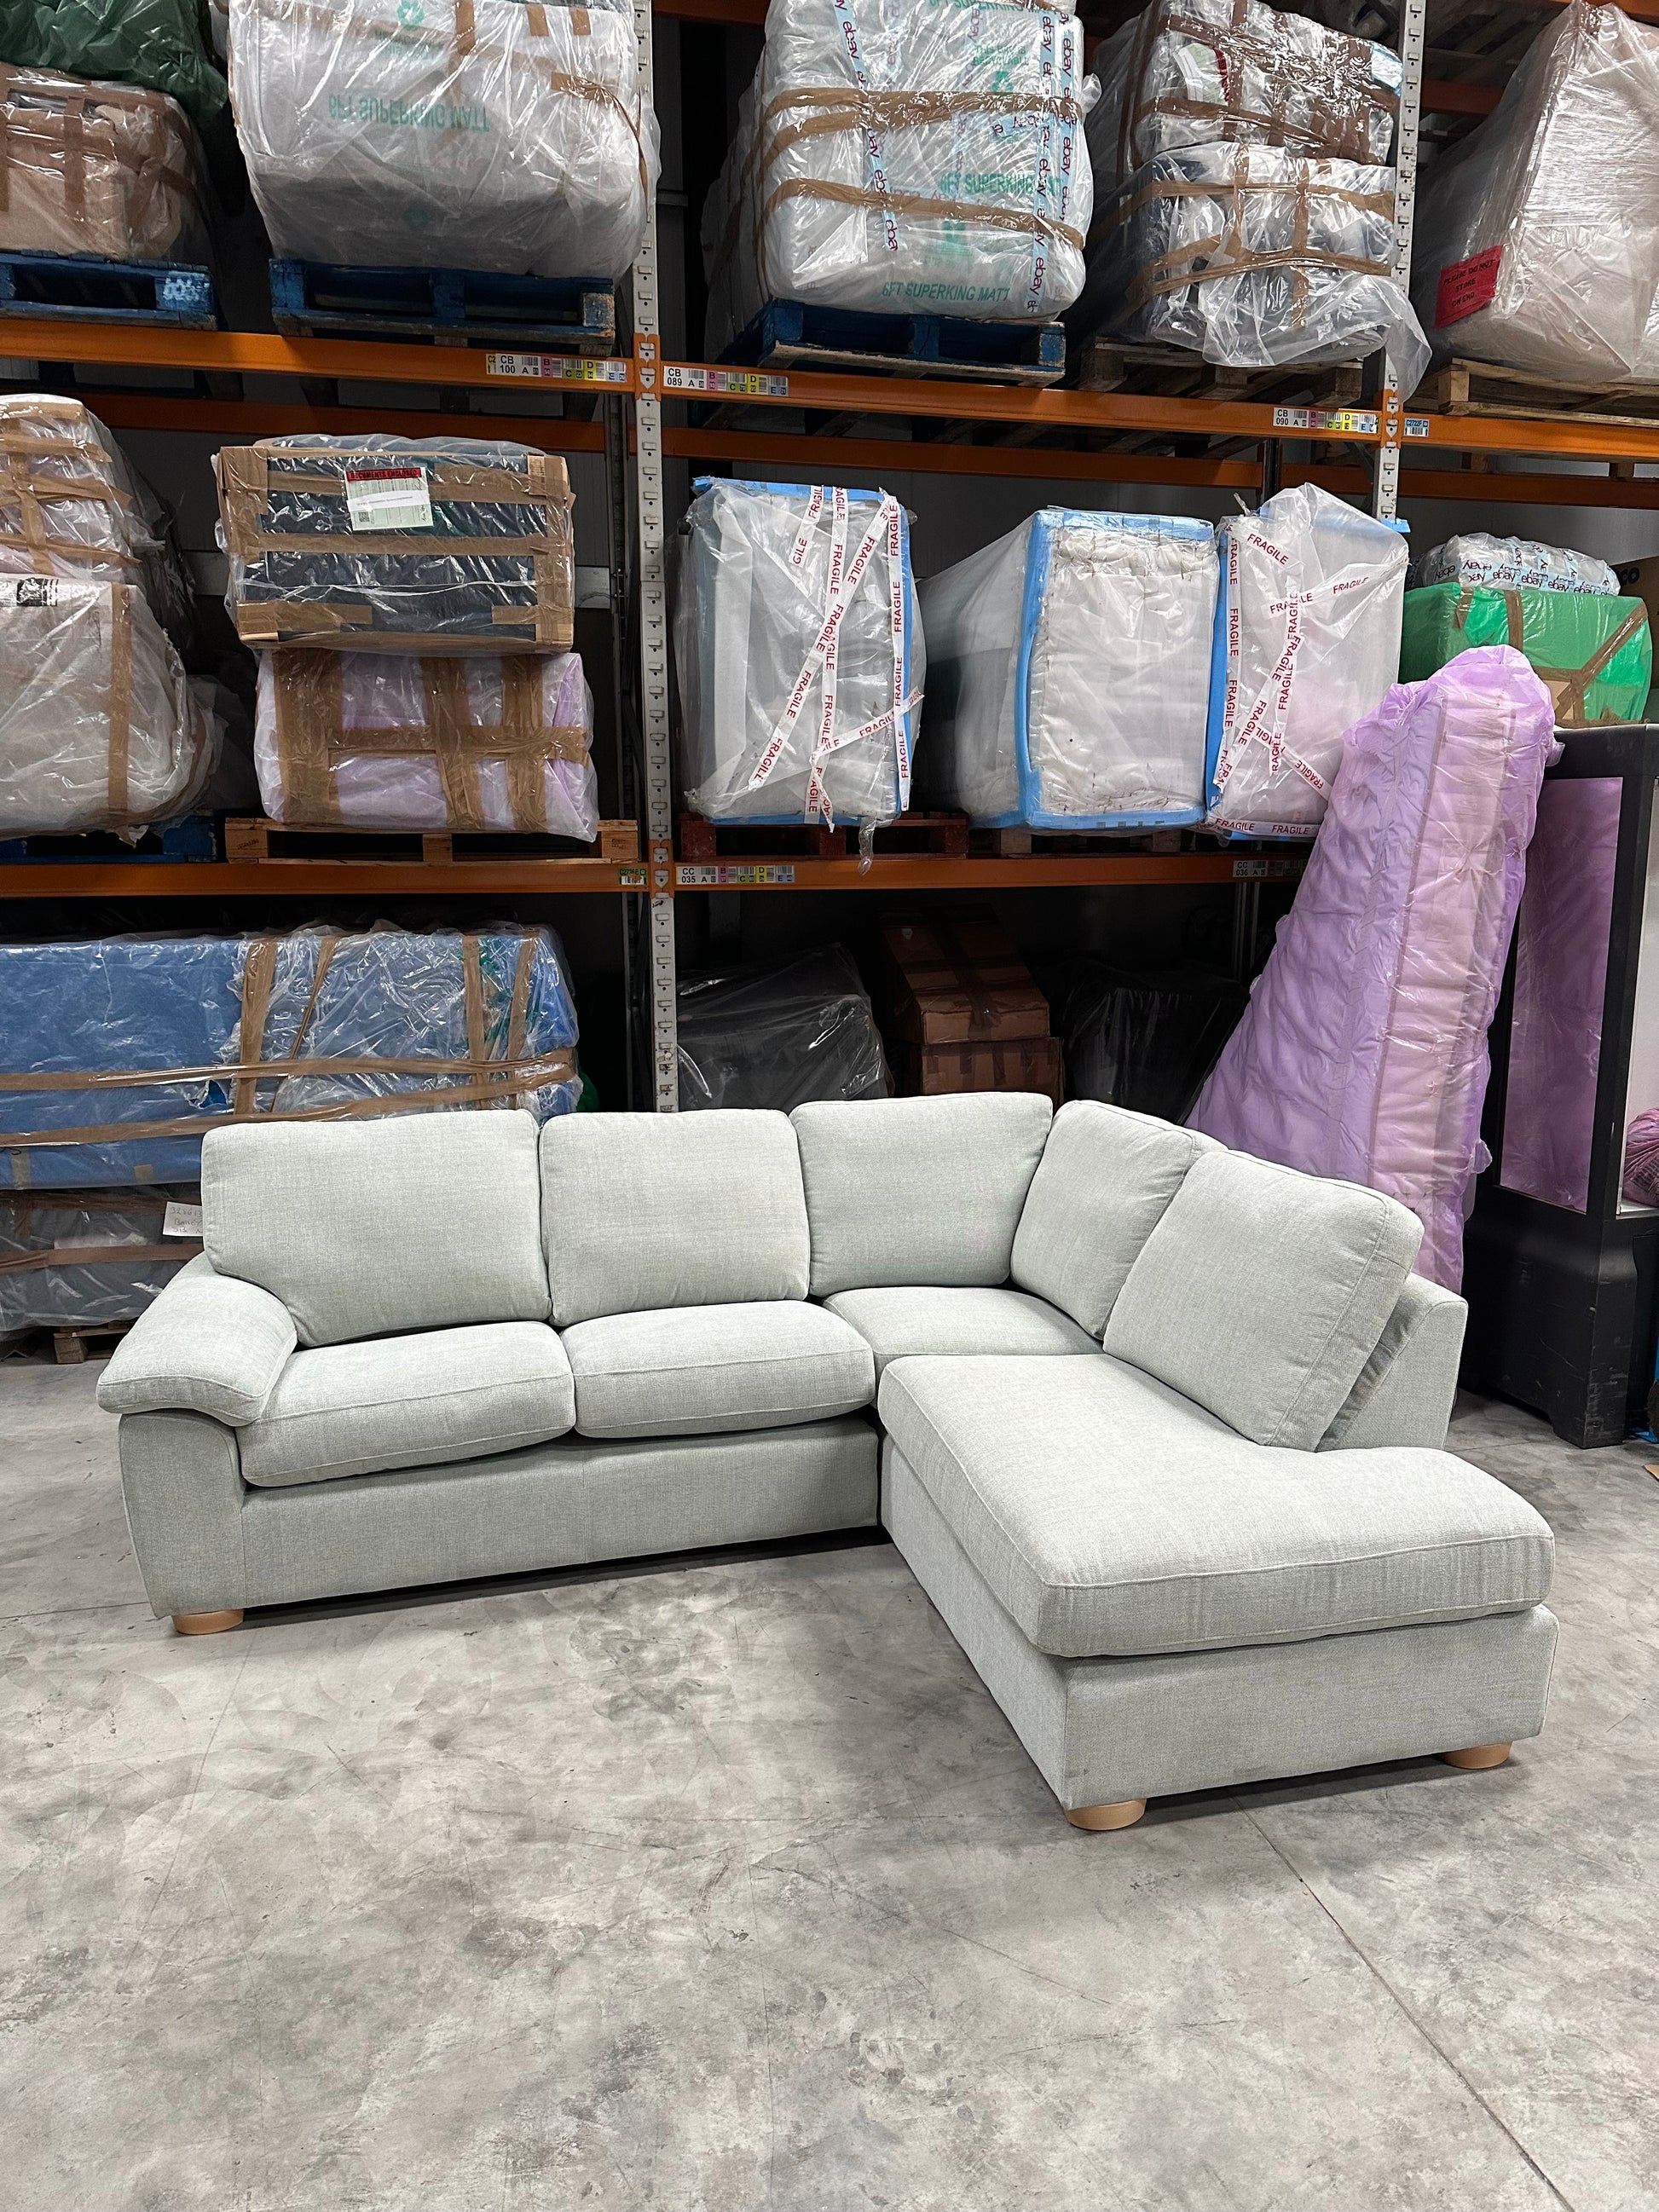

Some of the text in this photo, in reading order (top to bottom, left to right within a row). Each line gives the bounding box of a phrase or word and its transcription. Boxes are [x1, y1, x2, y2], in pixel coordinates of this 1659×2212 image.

[842, 21, 859, 60] ebay
[1043, 16, 1055, 52] ebay
[1062, 38, 1073, 77] ebay
[1061, 136, 1072, 176] ebay
[1037, 159, 1050, 197] ebay
[886, 219, 898, 251] eba
[882, 282, 1010, 302] 6FT SUPERKING MATT
[1029, 257, 1047, 295] ebay
[500, 355, 514, 364] CB
[500, 365, 516, 373] 100
[668, 368, 681, 377] CB
[667, 377, 682, 386] 089
[1277, 409, 1288, 418] CB
[835, 486, 846, 521] RAGILE
[889, 504, 899, 557] FRAGILE
[1247, 534, 1289, 565] FRAGILE
[830, 544, 843, 595] FRAGILE
[847, 536, 876, 585] FRAGILE
[1493, 572, 1516, 581] ebay
[1332, 577, 1369, 594] FRAGILE
[1521, 575, 1543, 587] ebay
[1548, 580, 1569, 592] ebay
[893, 581, 902, 632] FRAGILE
[1287, 592, 1298, 640] FRAGILE
[816, 604, 844, 652] FRAGILE
[1230, 608, 1239, 656] FRAGILE
[1272, 635, 1301, 681] FRAGILE
[787, 670, 811, 719] FRAGILE
[1225, 679, 1237, 727] FRAGILE
[1278, 663, 1293, 710] FRAGILE
[821, 695, 834, 744] FRAGILE
[1238, 700, 1267, 745] FRAGILE
[897, 731, 909, 778] FRAGILE
[1294, 759, 1324, 789] FRAGILE
[1215, 818, 1255, 832] FRAGILE
[1272, 824, 1310, 835] FRAGILE
